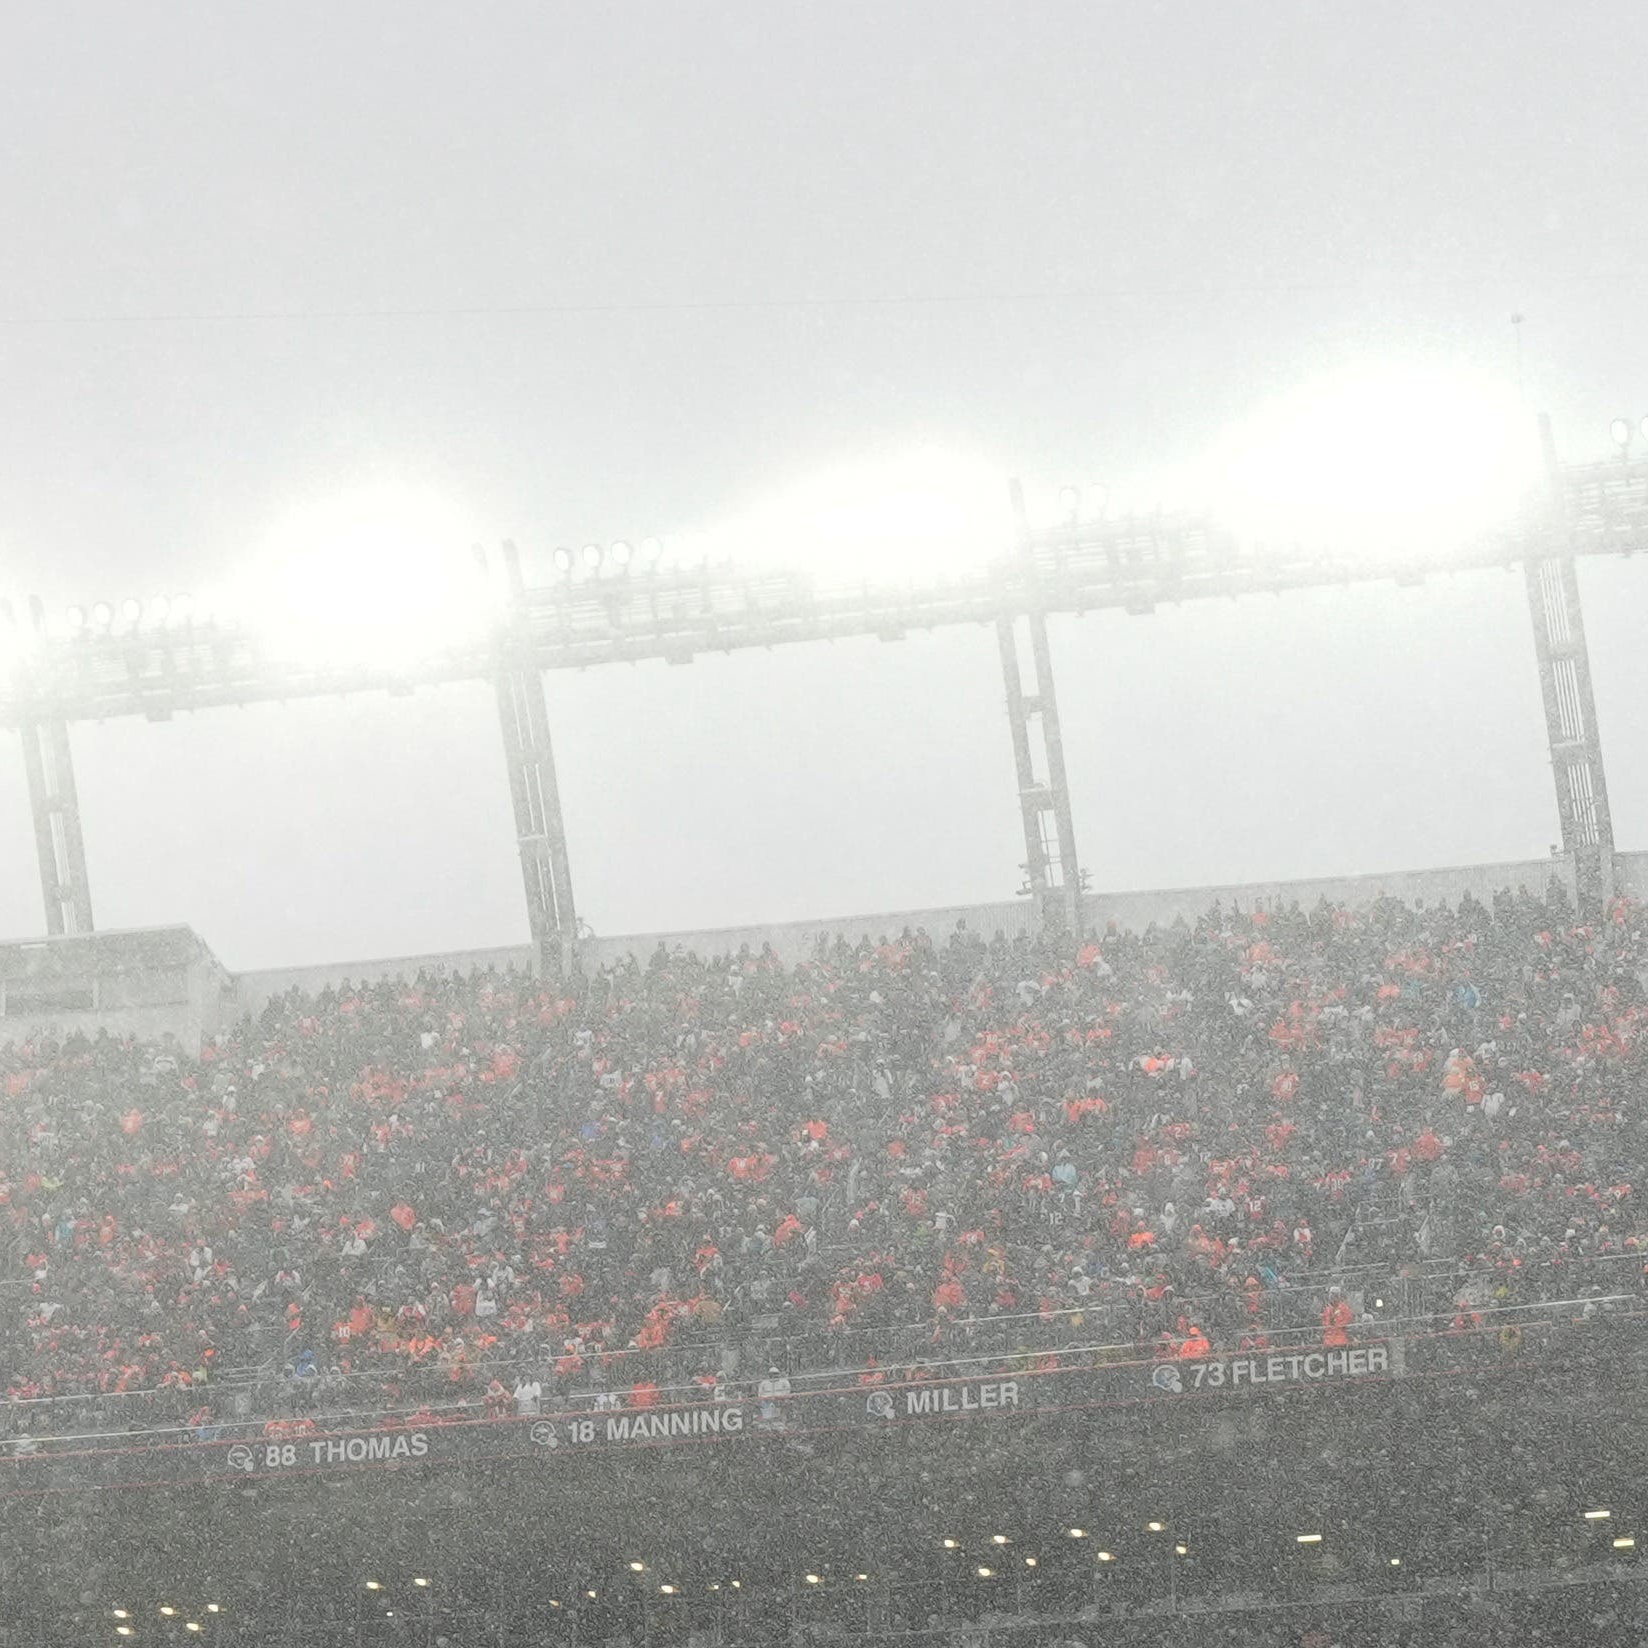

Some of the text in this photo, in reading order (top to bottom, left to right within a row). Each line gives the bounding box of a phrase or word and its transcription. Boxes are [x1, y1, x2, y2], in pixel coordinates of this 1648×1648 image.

[1190, 1347, 1390, 1387] 73 FLETCHER
[906, 1381, 1020, 1415] MILLER
[567, 1408, 744, 1443] 18 MANNING
[265, 1434, 429, 1467] 88 THOMAS
